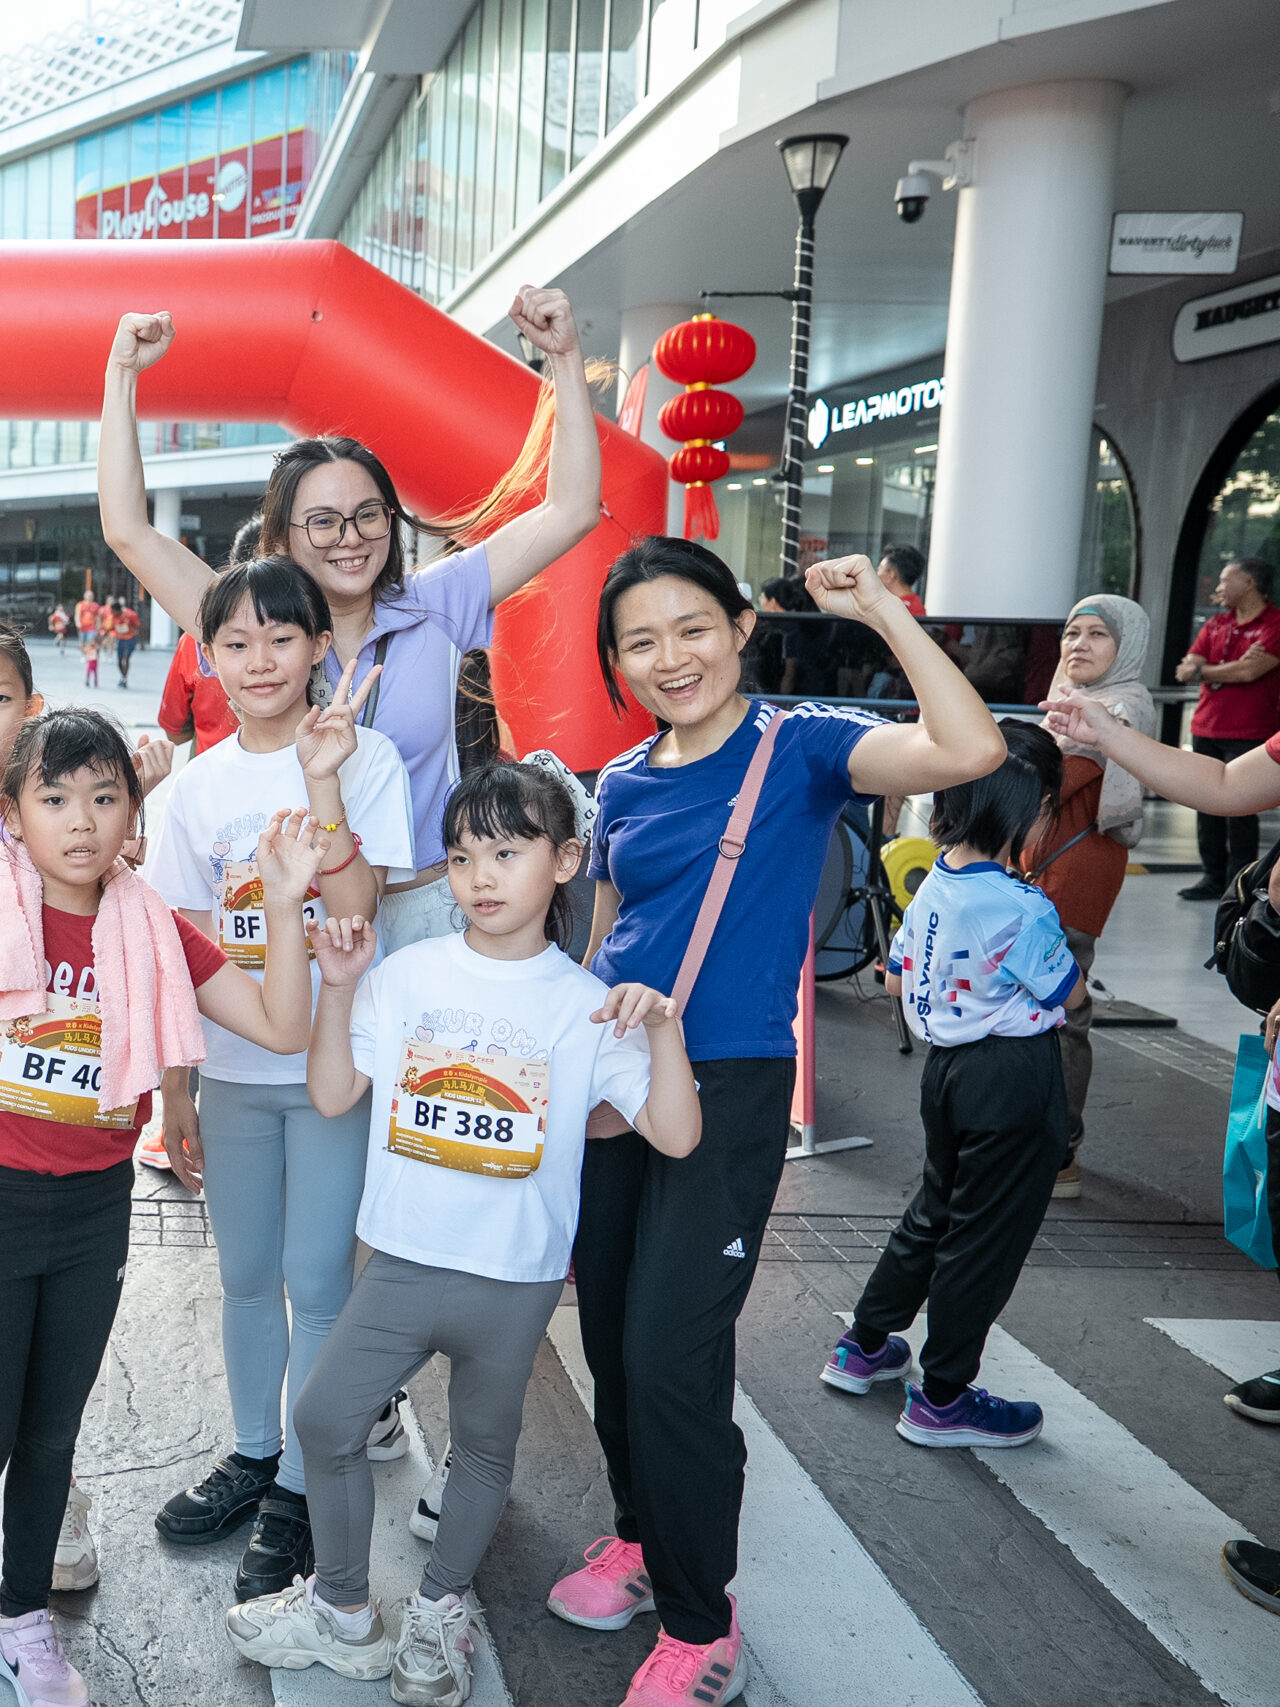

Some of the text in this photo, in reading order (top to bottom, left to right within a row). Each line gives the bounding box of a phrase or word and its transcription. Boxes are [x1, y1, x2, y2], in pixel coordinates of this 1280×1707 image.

[234, 915, 261, 939] BF
[64, 1031, 100, 1046] 马儿马儿
[22, 1052, 67, 1084] BF
[414, 1100, 514, 1143] BF 388
[723, 1249, 746, 1258] adidas
